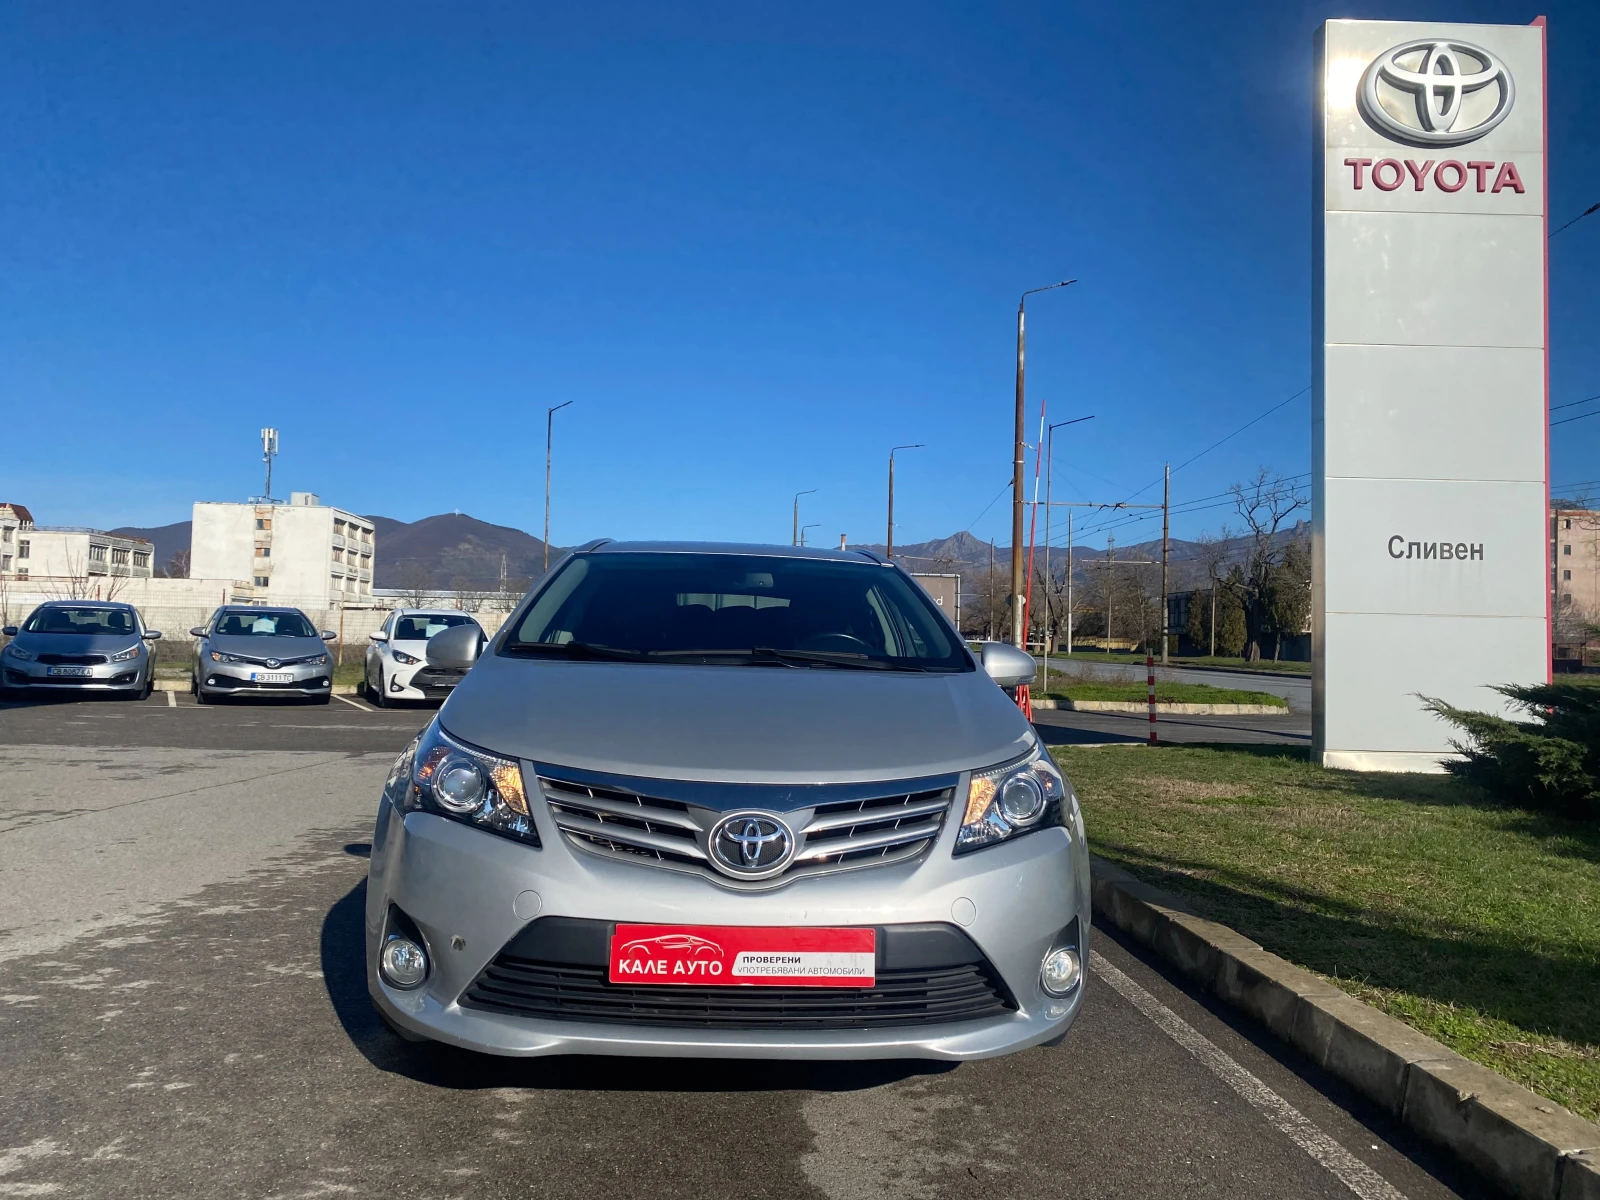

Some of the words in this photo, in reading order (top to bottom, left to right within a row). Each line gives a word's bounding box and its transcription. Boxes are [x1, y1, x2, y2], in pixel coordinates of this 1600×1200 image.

[1344, 158, 1525, 193] TOYOTA
[1388, 534, 1484, 560] Сливен
[619, 959, 668, 975] КАЛЕ
[673, 960, 723, 975] АУТО
[742, 956, 801, 964] ПРОВЕРЕНИ
[807, 967, 866, 975] АВТОМОБИЛИ
